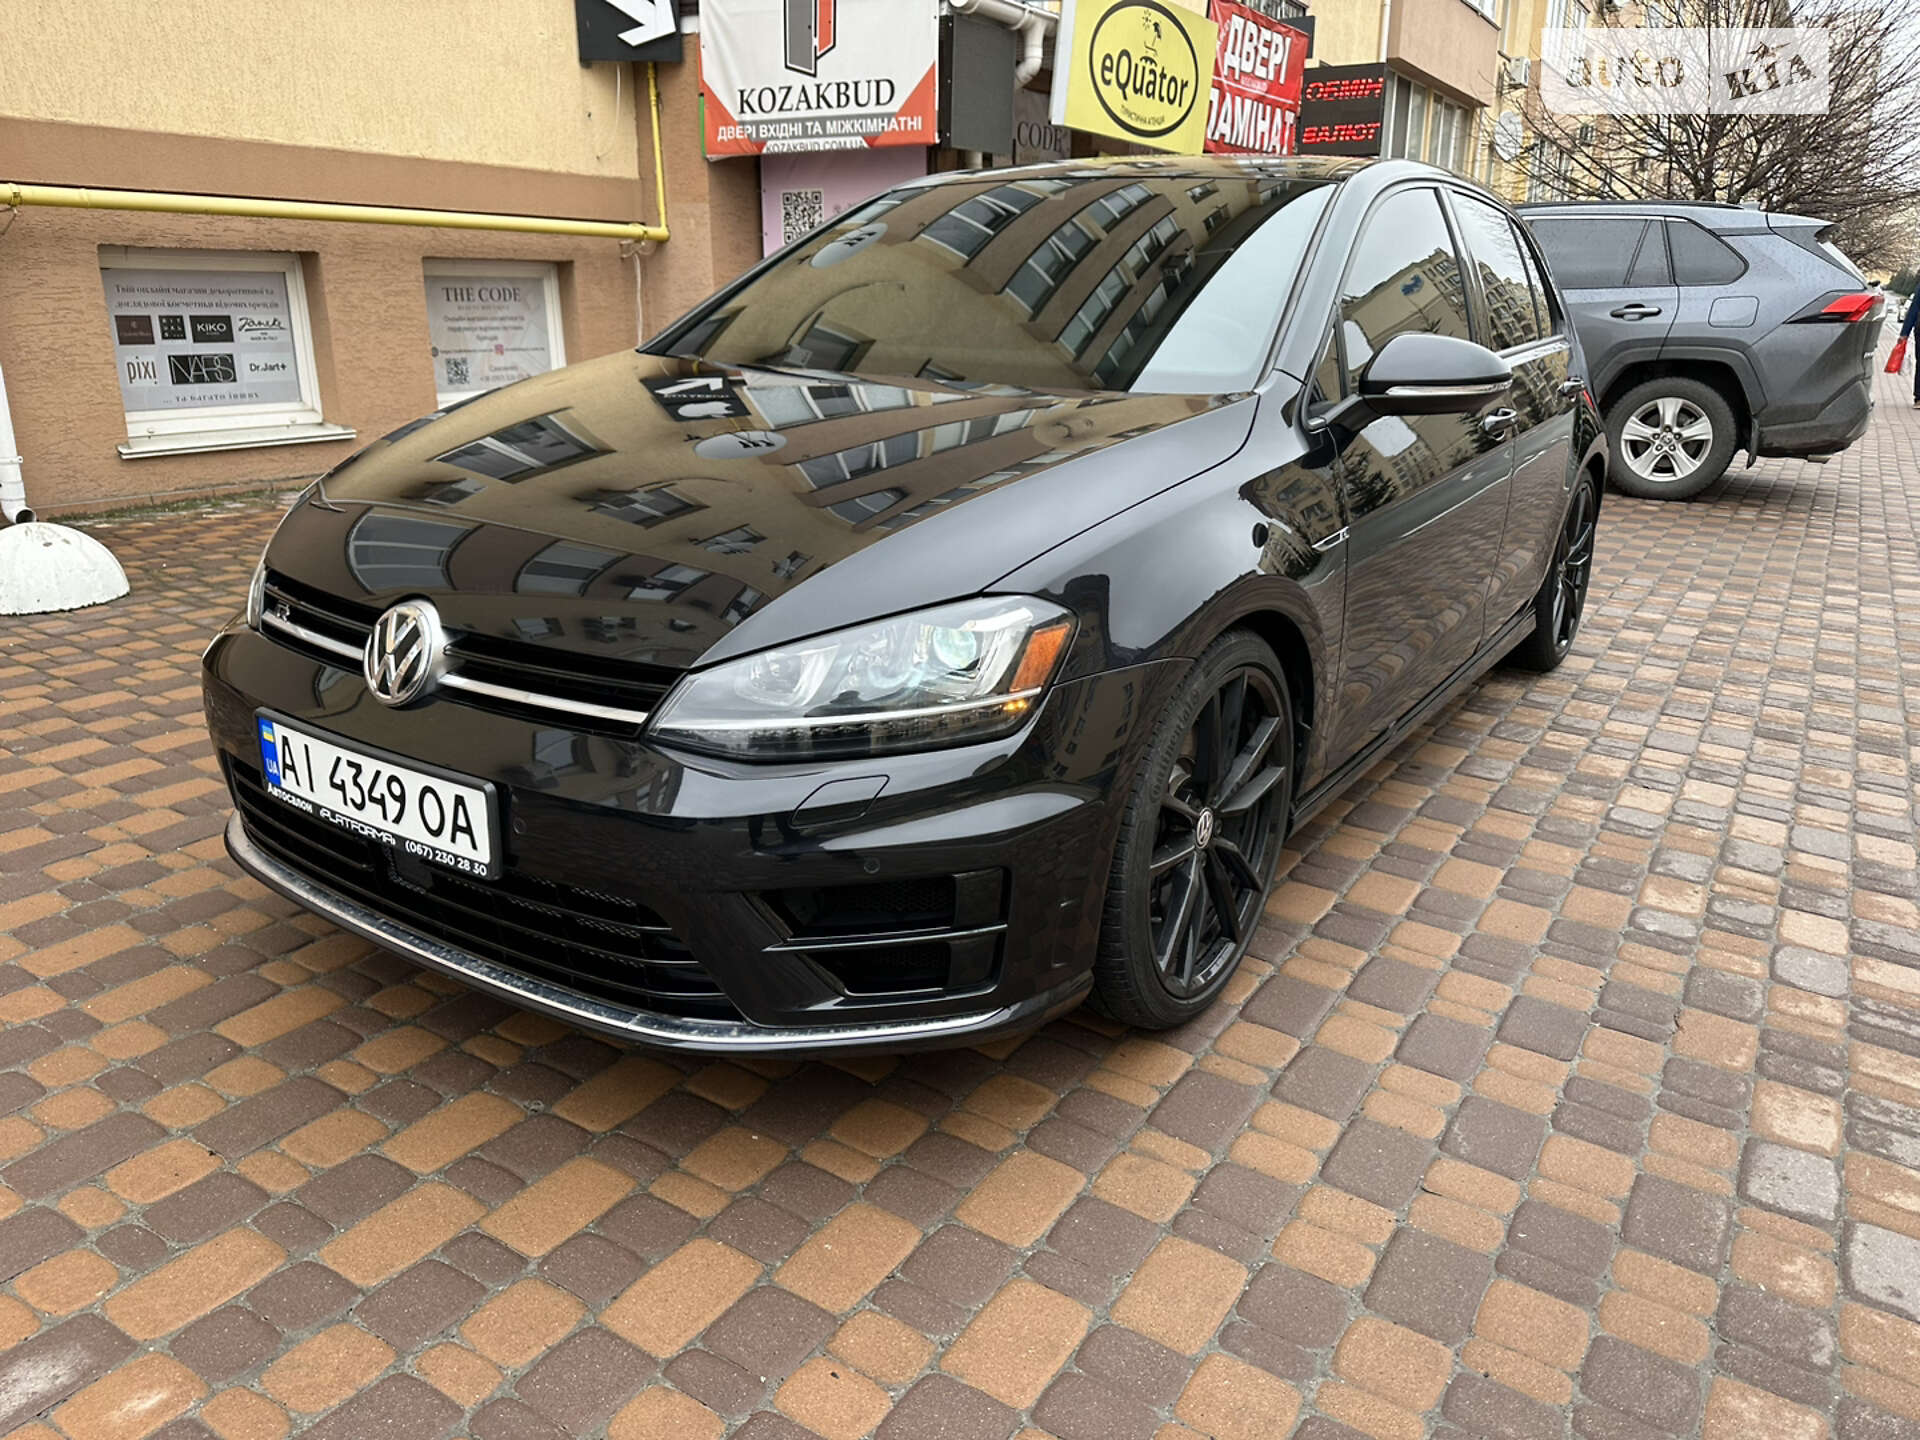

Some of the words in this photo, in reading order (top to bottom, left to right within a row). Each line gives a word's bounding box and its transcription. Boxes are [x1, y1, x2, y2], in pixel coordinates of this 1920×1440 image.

[1223, 13, 1292, 85] ДВЕРІ
[1101, 48, 1188, 108] eQuator
[1306, 77, 1384, 101] ОБМІН
[738, 78, 895, 115] KOZAKBUD
[717, 125, 756, 142] ДВЕРІ
[759, 120, 802, 140] ВХІДНІ
[805, 120, 823, 135] ТА
[826, 116, 922, 134] МІЖКІМНАТНІ
[1302, 122, 1381, 145] ВАЛЮТ
[765, 138, 866, 153] KOZAKBUD.COM.UA
[442, 287, 475, 302] THE
[478, 286, 521, 303] CODE
[196, 322, 227, 332] KIKO
[168, 353, 238, 385] NARS
[265, 757, 280, 775] UA
[281, 734, 315, 793] AI
[328, 755, 407, 825] 4349
[418, 785, 478, 851] OA
[266, 782, 313, 814] Автосалон
[404, 839, 434, 860] (067)
[434, 850, 455, 867] 230
[456, 857, 472, 873] 28
[472, 864, 488, 877] 30
